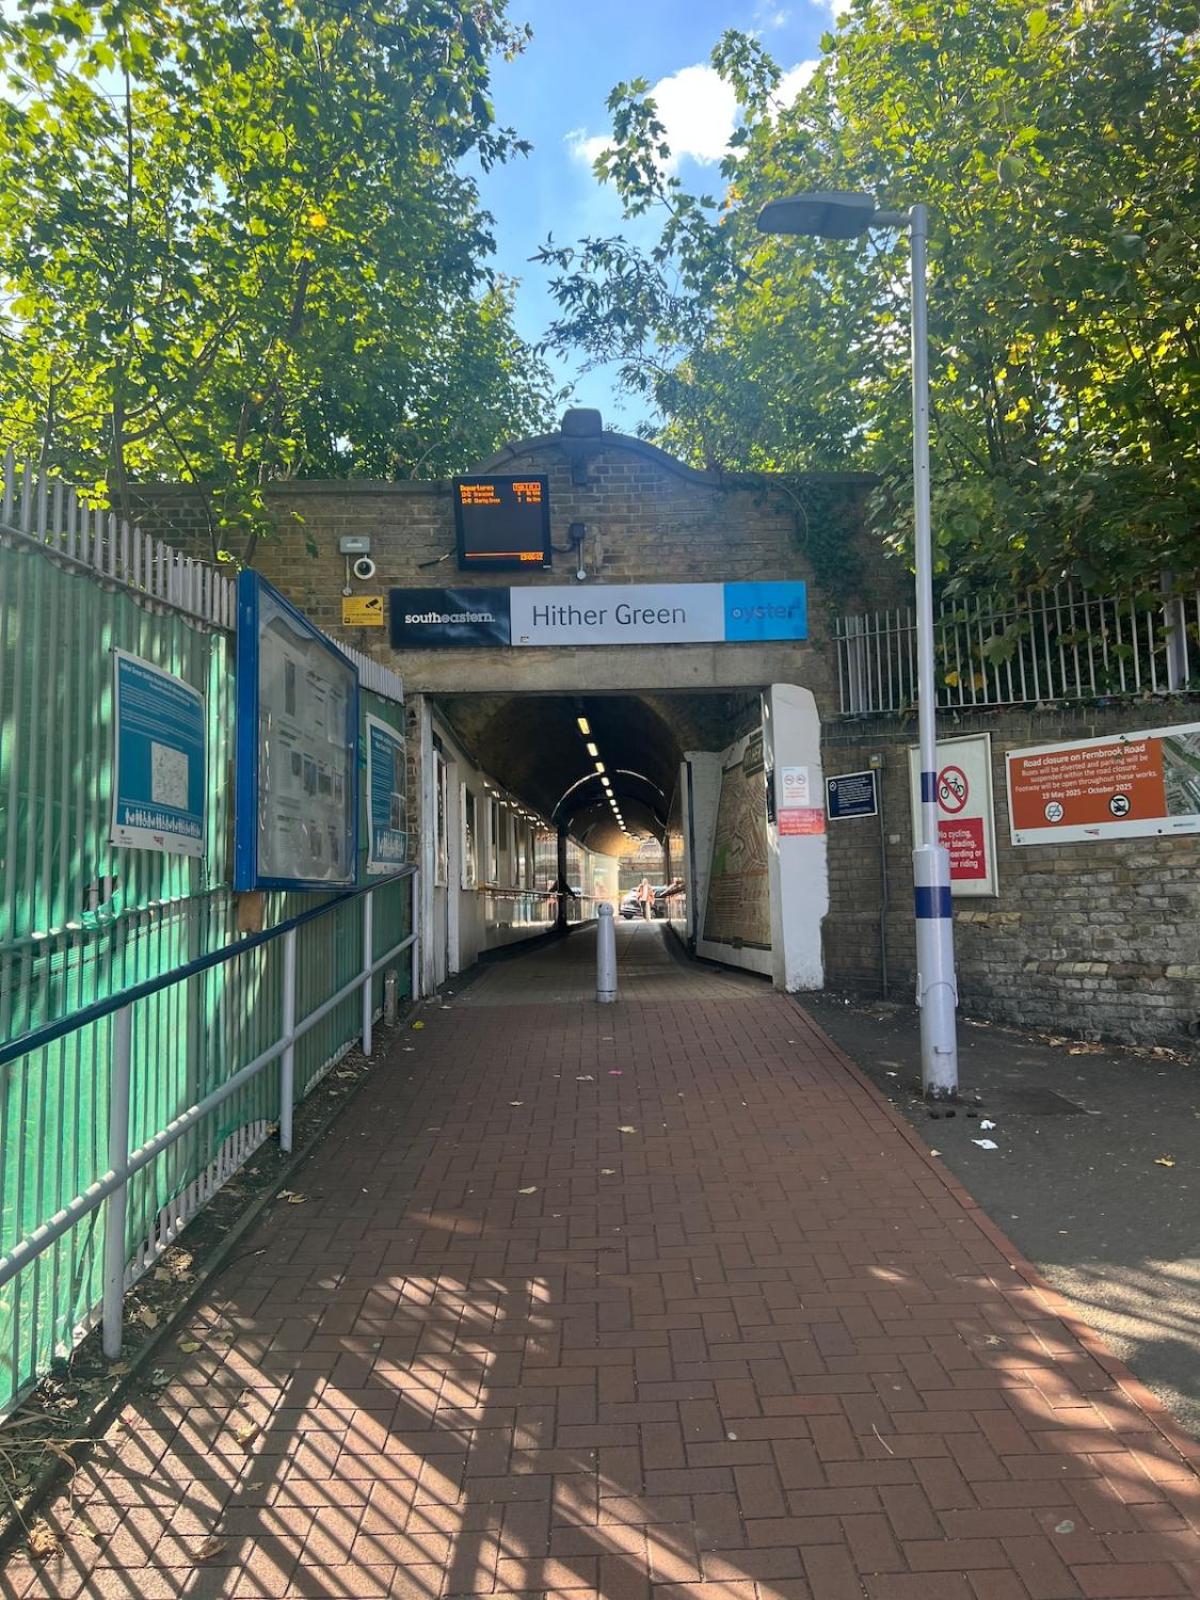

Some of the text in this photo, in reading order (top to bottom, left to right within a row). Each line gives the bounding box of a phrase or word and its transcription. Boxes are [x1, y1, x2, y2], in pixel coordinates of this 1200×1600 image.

[533, 603, 686, 626] Hither Green
[731, 603, 797, 624] oyster
[1023, 743, 1146, 768] Road closure on Fernbrook Road
[1040, 766, 1051, 774] will
[1051, 765, 1059, 773] be
[1087, 760, 1099, 769] and
[1126, 754, 1139, 763] will
[1139, 754, 1149, 762] be
[1084, 768, 1095, 777] the
[1096, 767, 1111, 775] road
[1051, 790, 1065, 799] May
[1087, 785, 1115, 794] October
[1052, 781, 1061, 789] be
